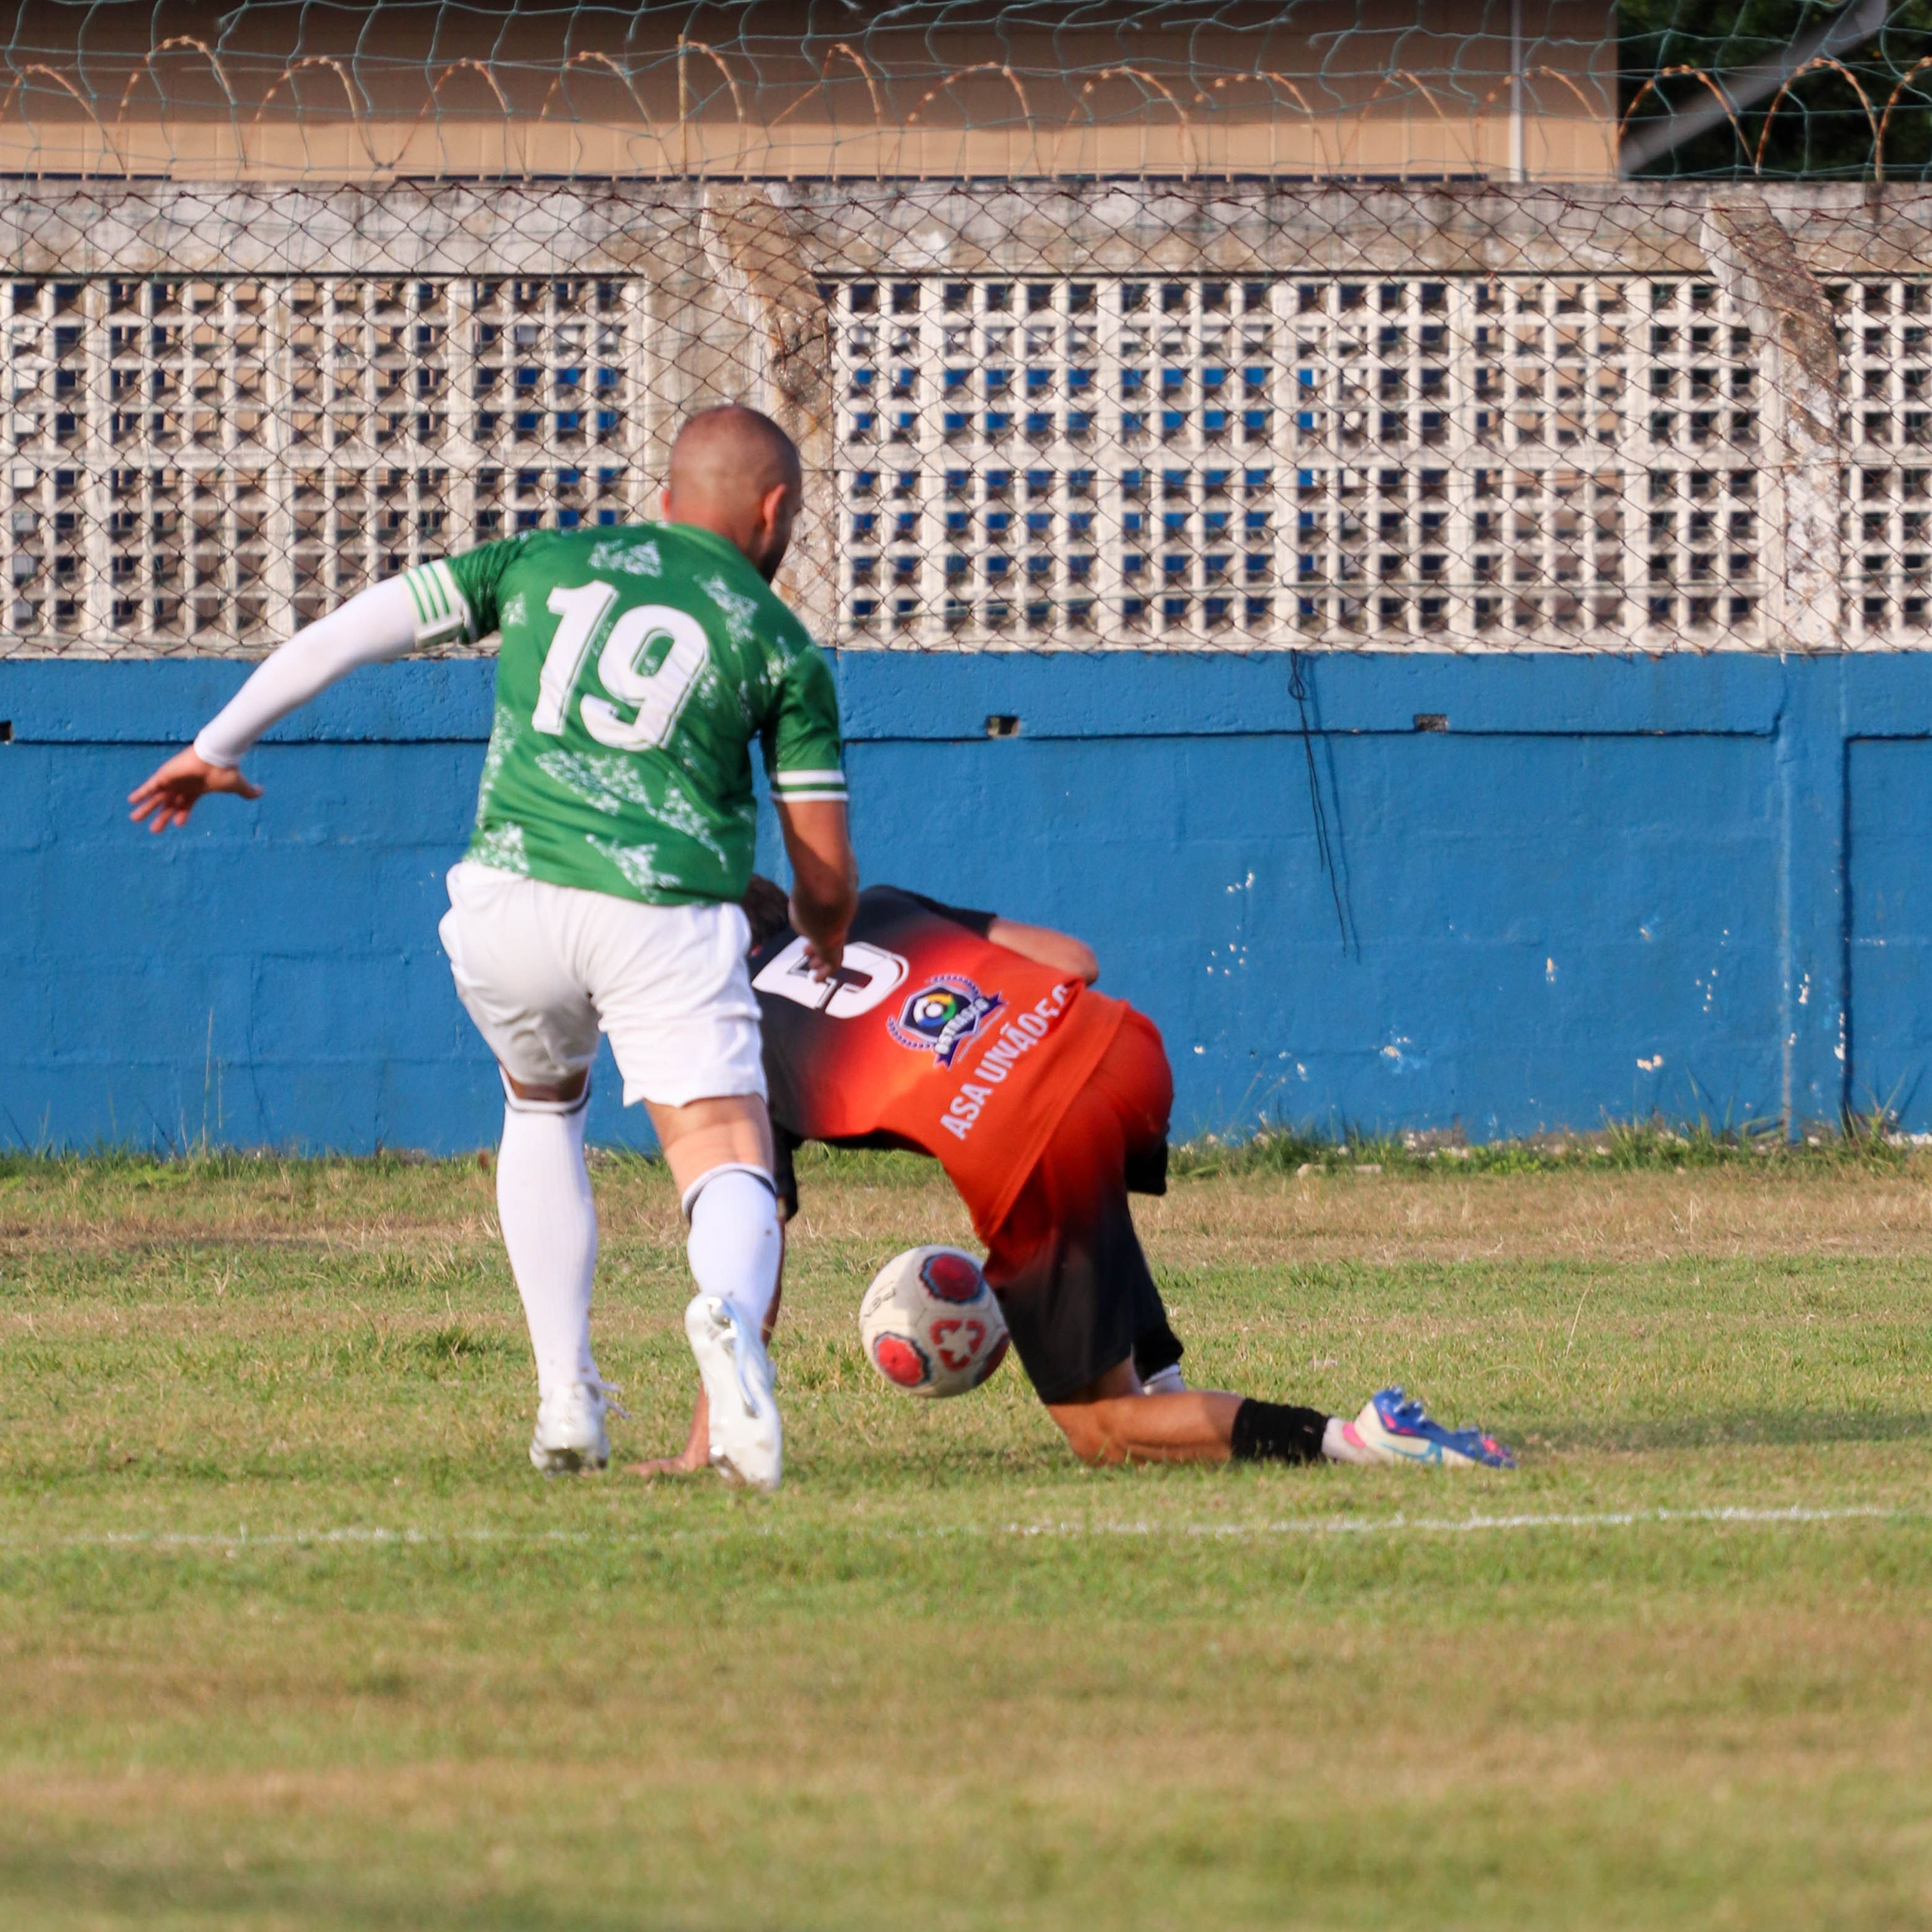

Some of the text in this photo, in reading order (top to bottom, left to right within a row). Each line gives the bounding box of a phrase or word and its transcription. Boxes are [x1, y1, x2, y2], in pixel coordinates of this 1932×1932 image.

[532, 580, 711, 752] 19
[751, 935, 909, 1019] 5
[940, 1083, 993, 1140] ASA
